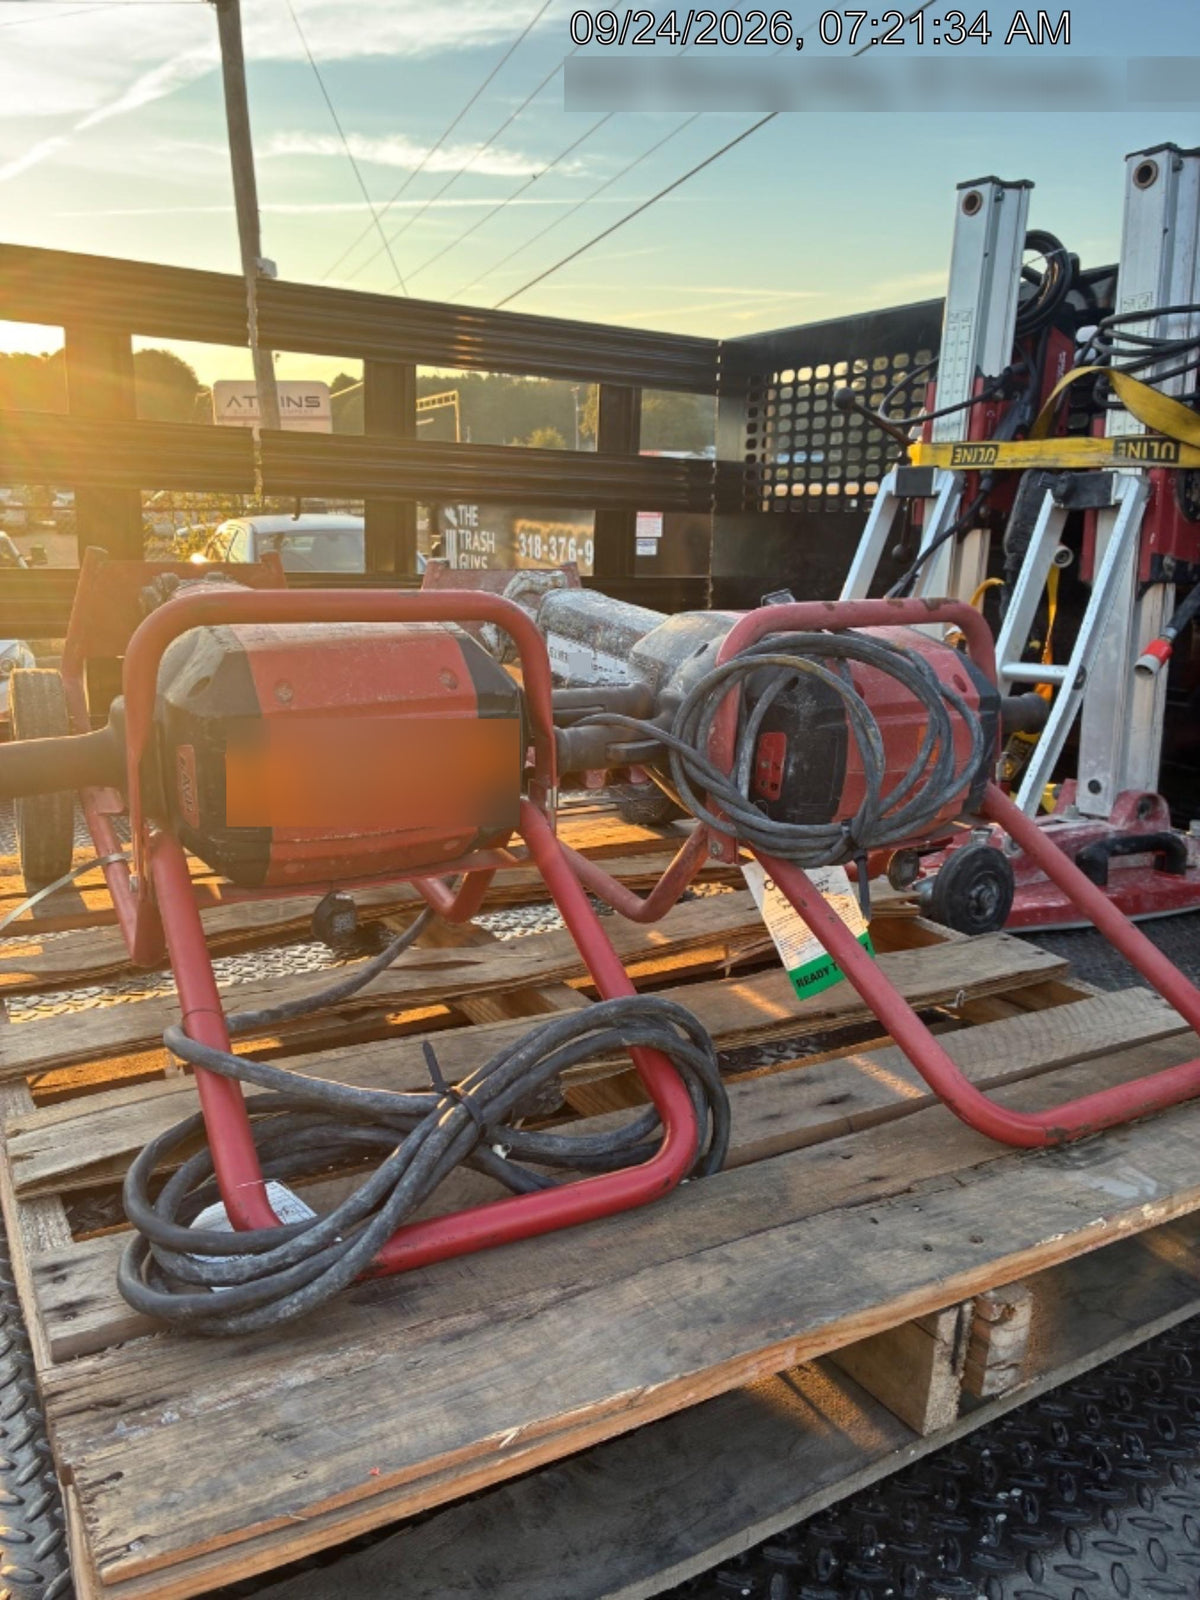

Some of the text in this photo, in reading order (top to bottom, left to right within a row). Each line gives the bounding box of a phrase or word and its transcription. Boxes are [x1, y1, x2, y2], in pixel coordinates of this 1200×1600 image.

[226, 395, 321, 408] ATINS
[953, 447, 996, 464] ULINE
[1117, 441, 1175, 460] ULINE
[458, 504, 479, 527] THE
[458, 529, 495, 554] TRASH
[519, 533, 594, 567] 318-376-9
[796, 965, 830, 988] READY
